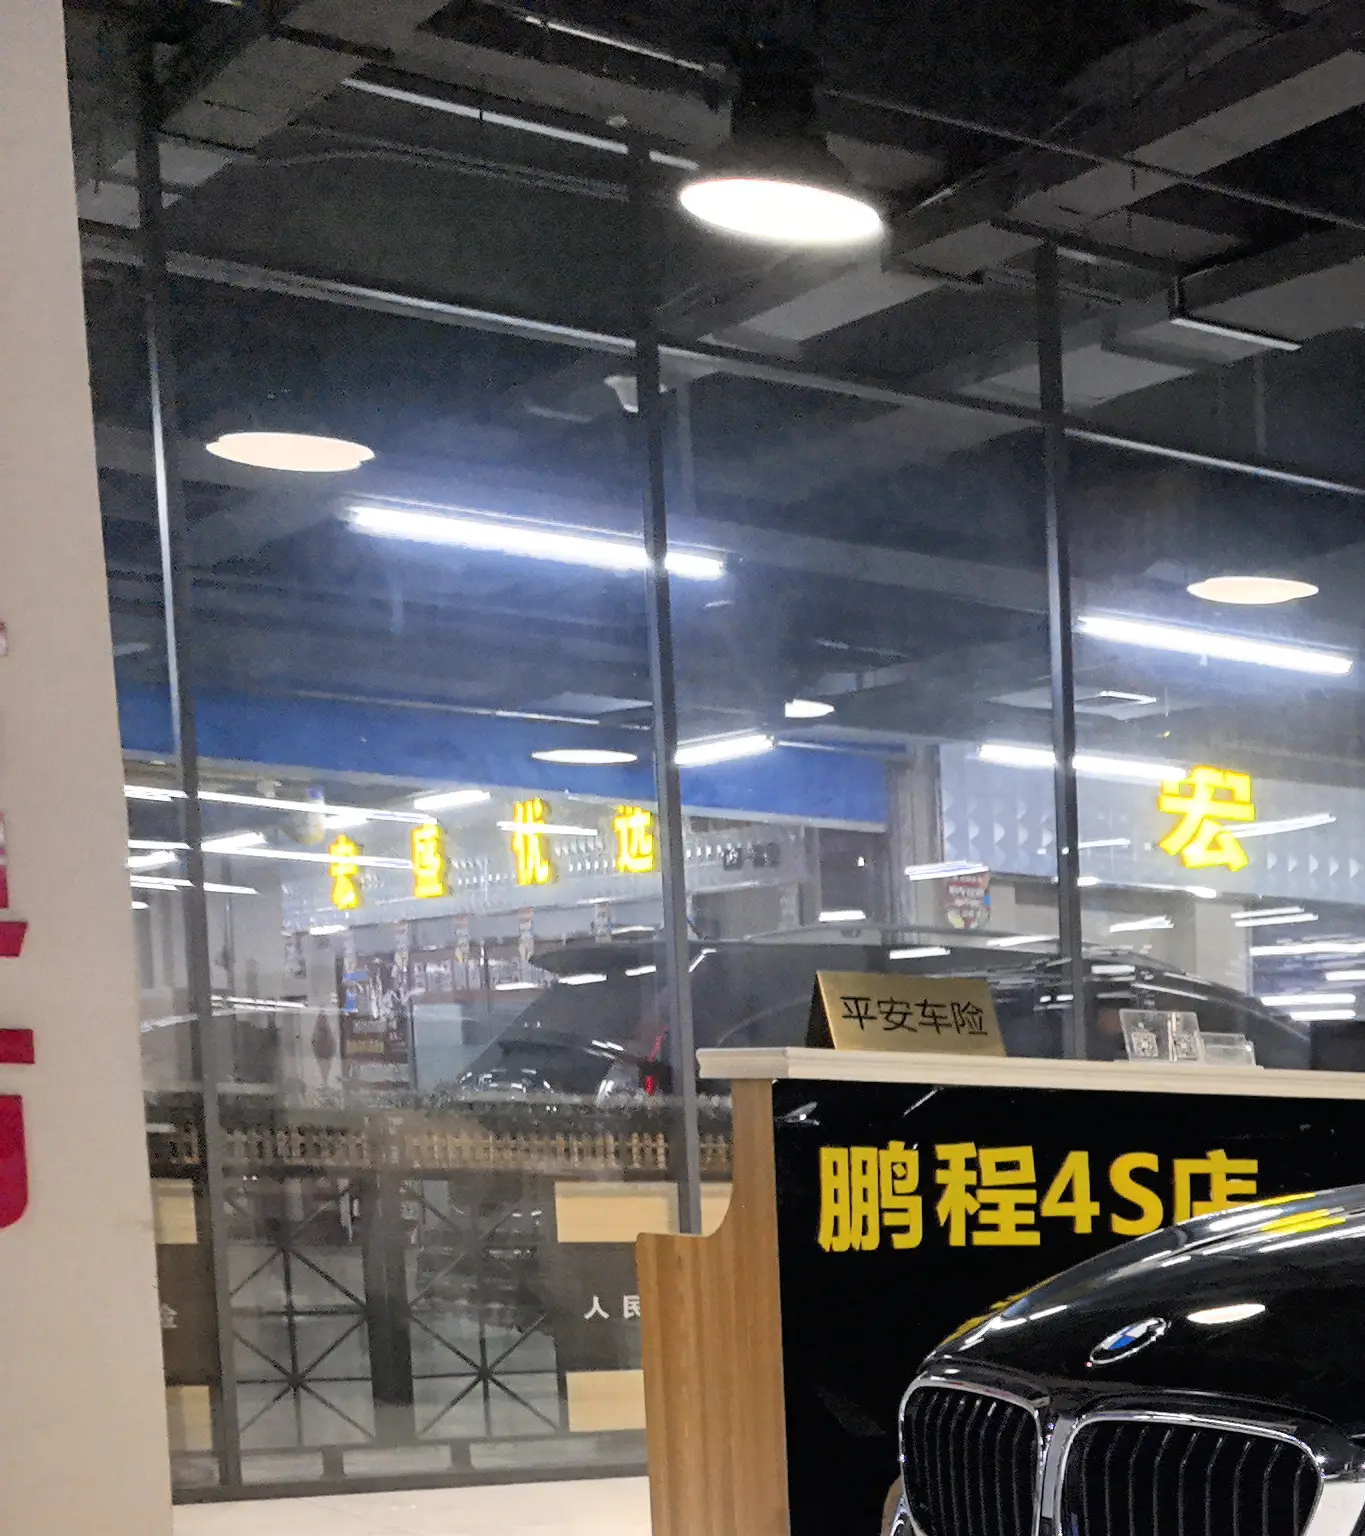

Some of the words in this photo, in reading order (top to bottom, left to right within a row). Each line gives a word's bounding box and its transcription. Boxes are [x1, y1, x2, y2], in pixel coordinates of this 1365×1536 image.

[840, 996, 988, 1035] 平安车险
[819, 1141, 1258, 1252] 鹏程4S店
